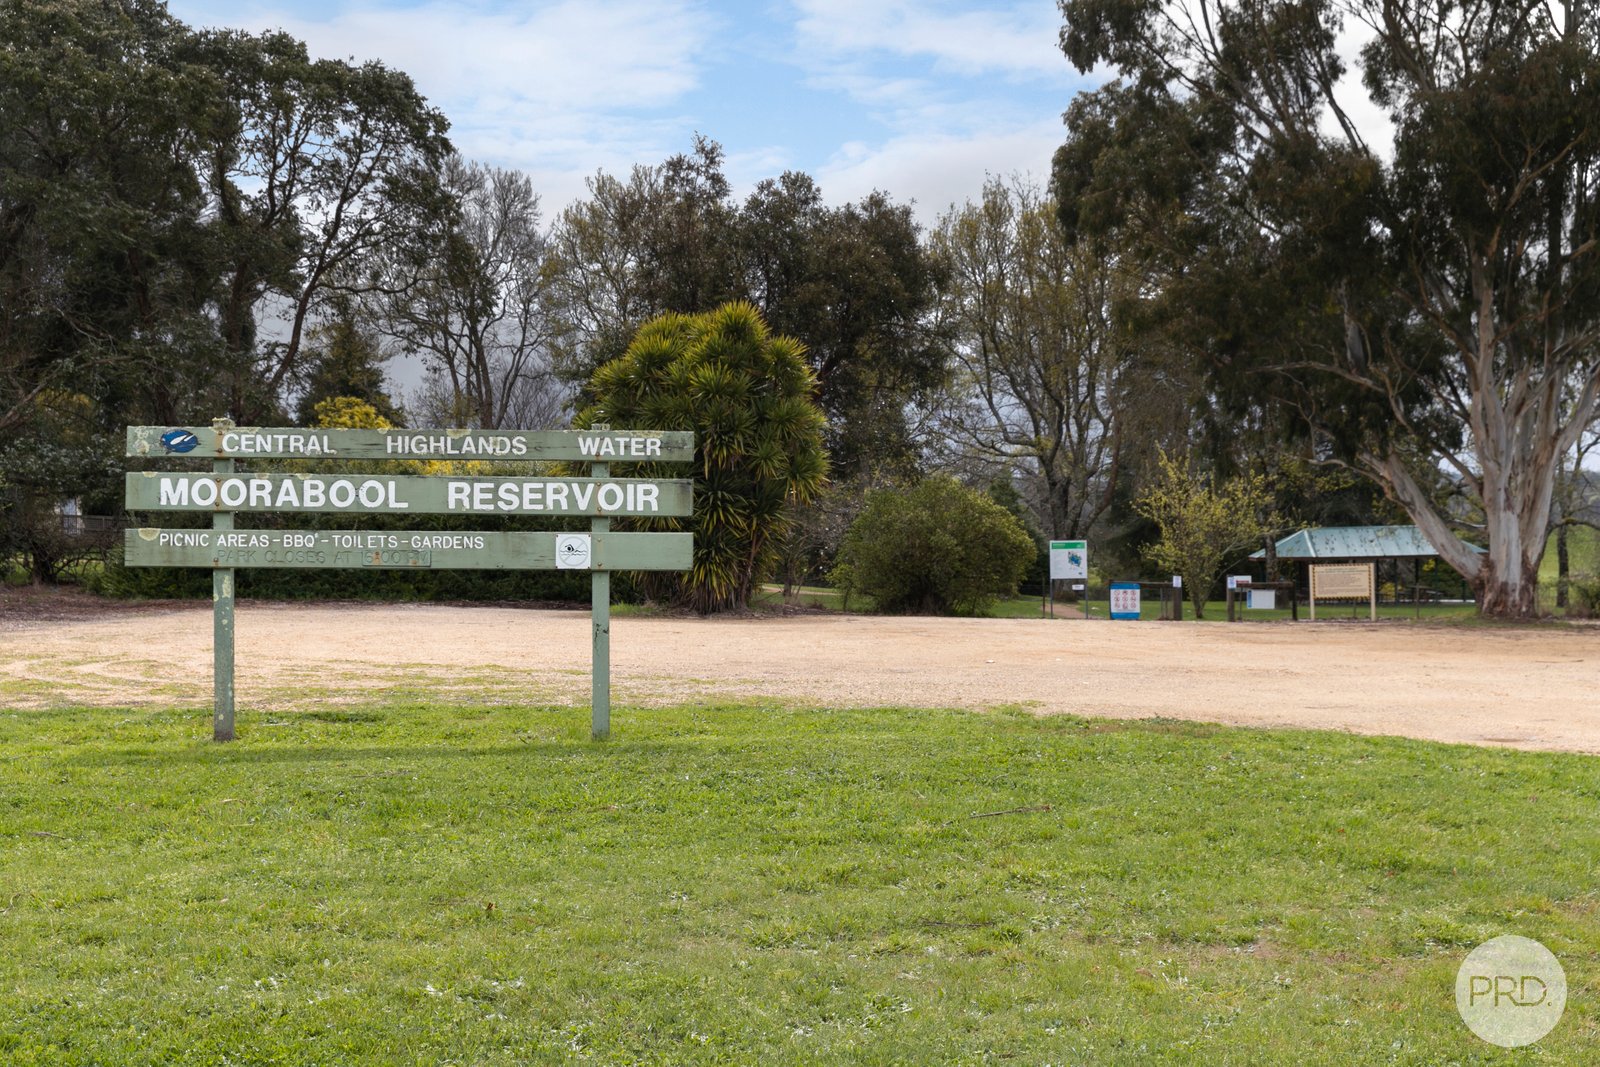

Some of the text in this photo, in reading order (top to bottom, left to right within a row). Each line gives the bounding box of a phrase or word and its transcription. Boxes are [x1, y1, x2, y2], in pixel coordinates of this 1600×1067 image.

[222, 433, 662, 456] CENTRAL HIGHLANDS WATER
[160, 478, 659, 511] MOORABOOL RESERVOIR
[159, 533, 209, 547] PICNIC
[217, 550, 257, 563] PARK
[264, 550, 326, 564] CLOSES
[333, 551, 353, 564] AT
